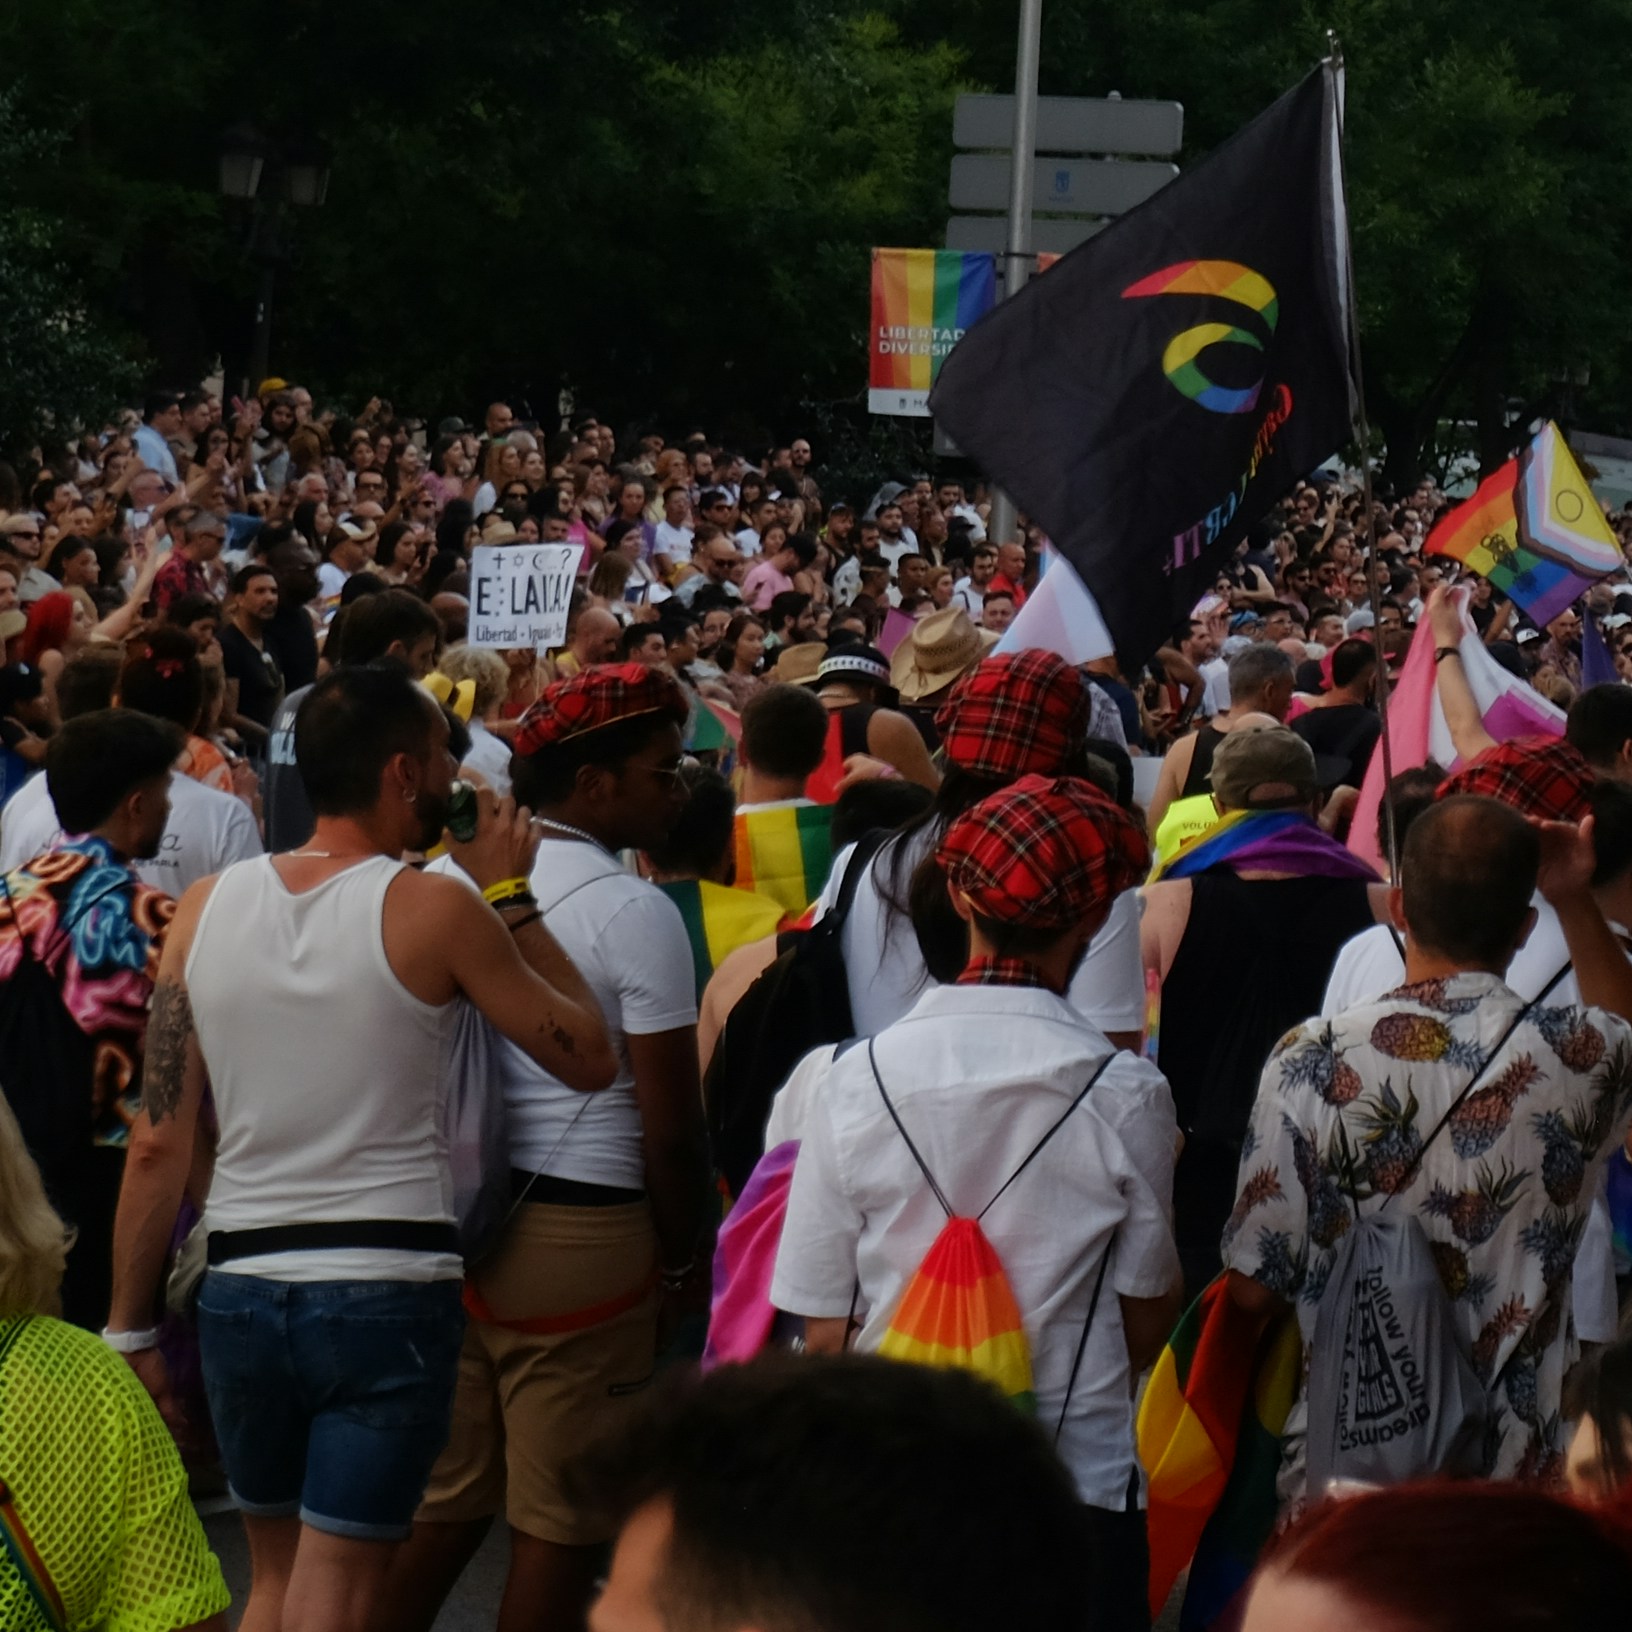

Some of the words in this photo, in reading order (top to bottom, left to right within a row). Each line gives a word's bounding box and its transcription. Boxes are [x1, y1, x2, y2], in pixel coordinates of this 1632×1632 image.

[476, 624, 518, 643] Libertad
[1390, 1344, 1427, 1402] your
[1348, 1402, 1432, 1448] dreams
